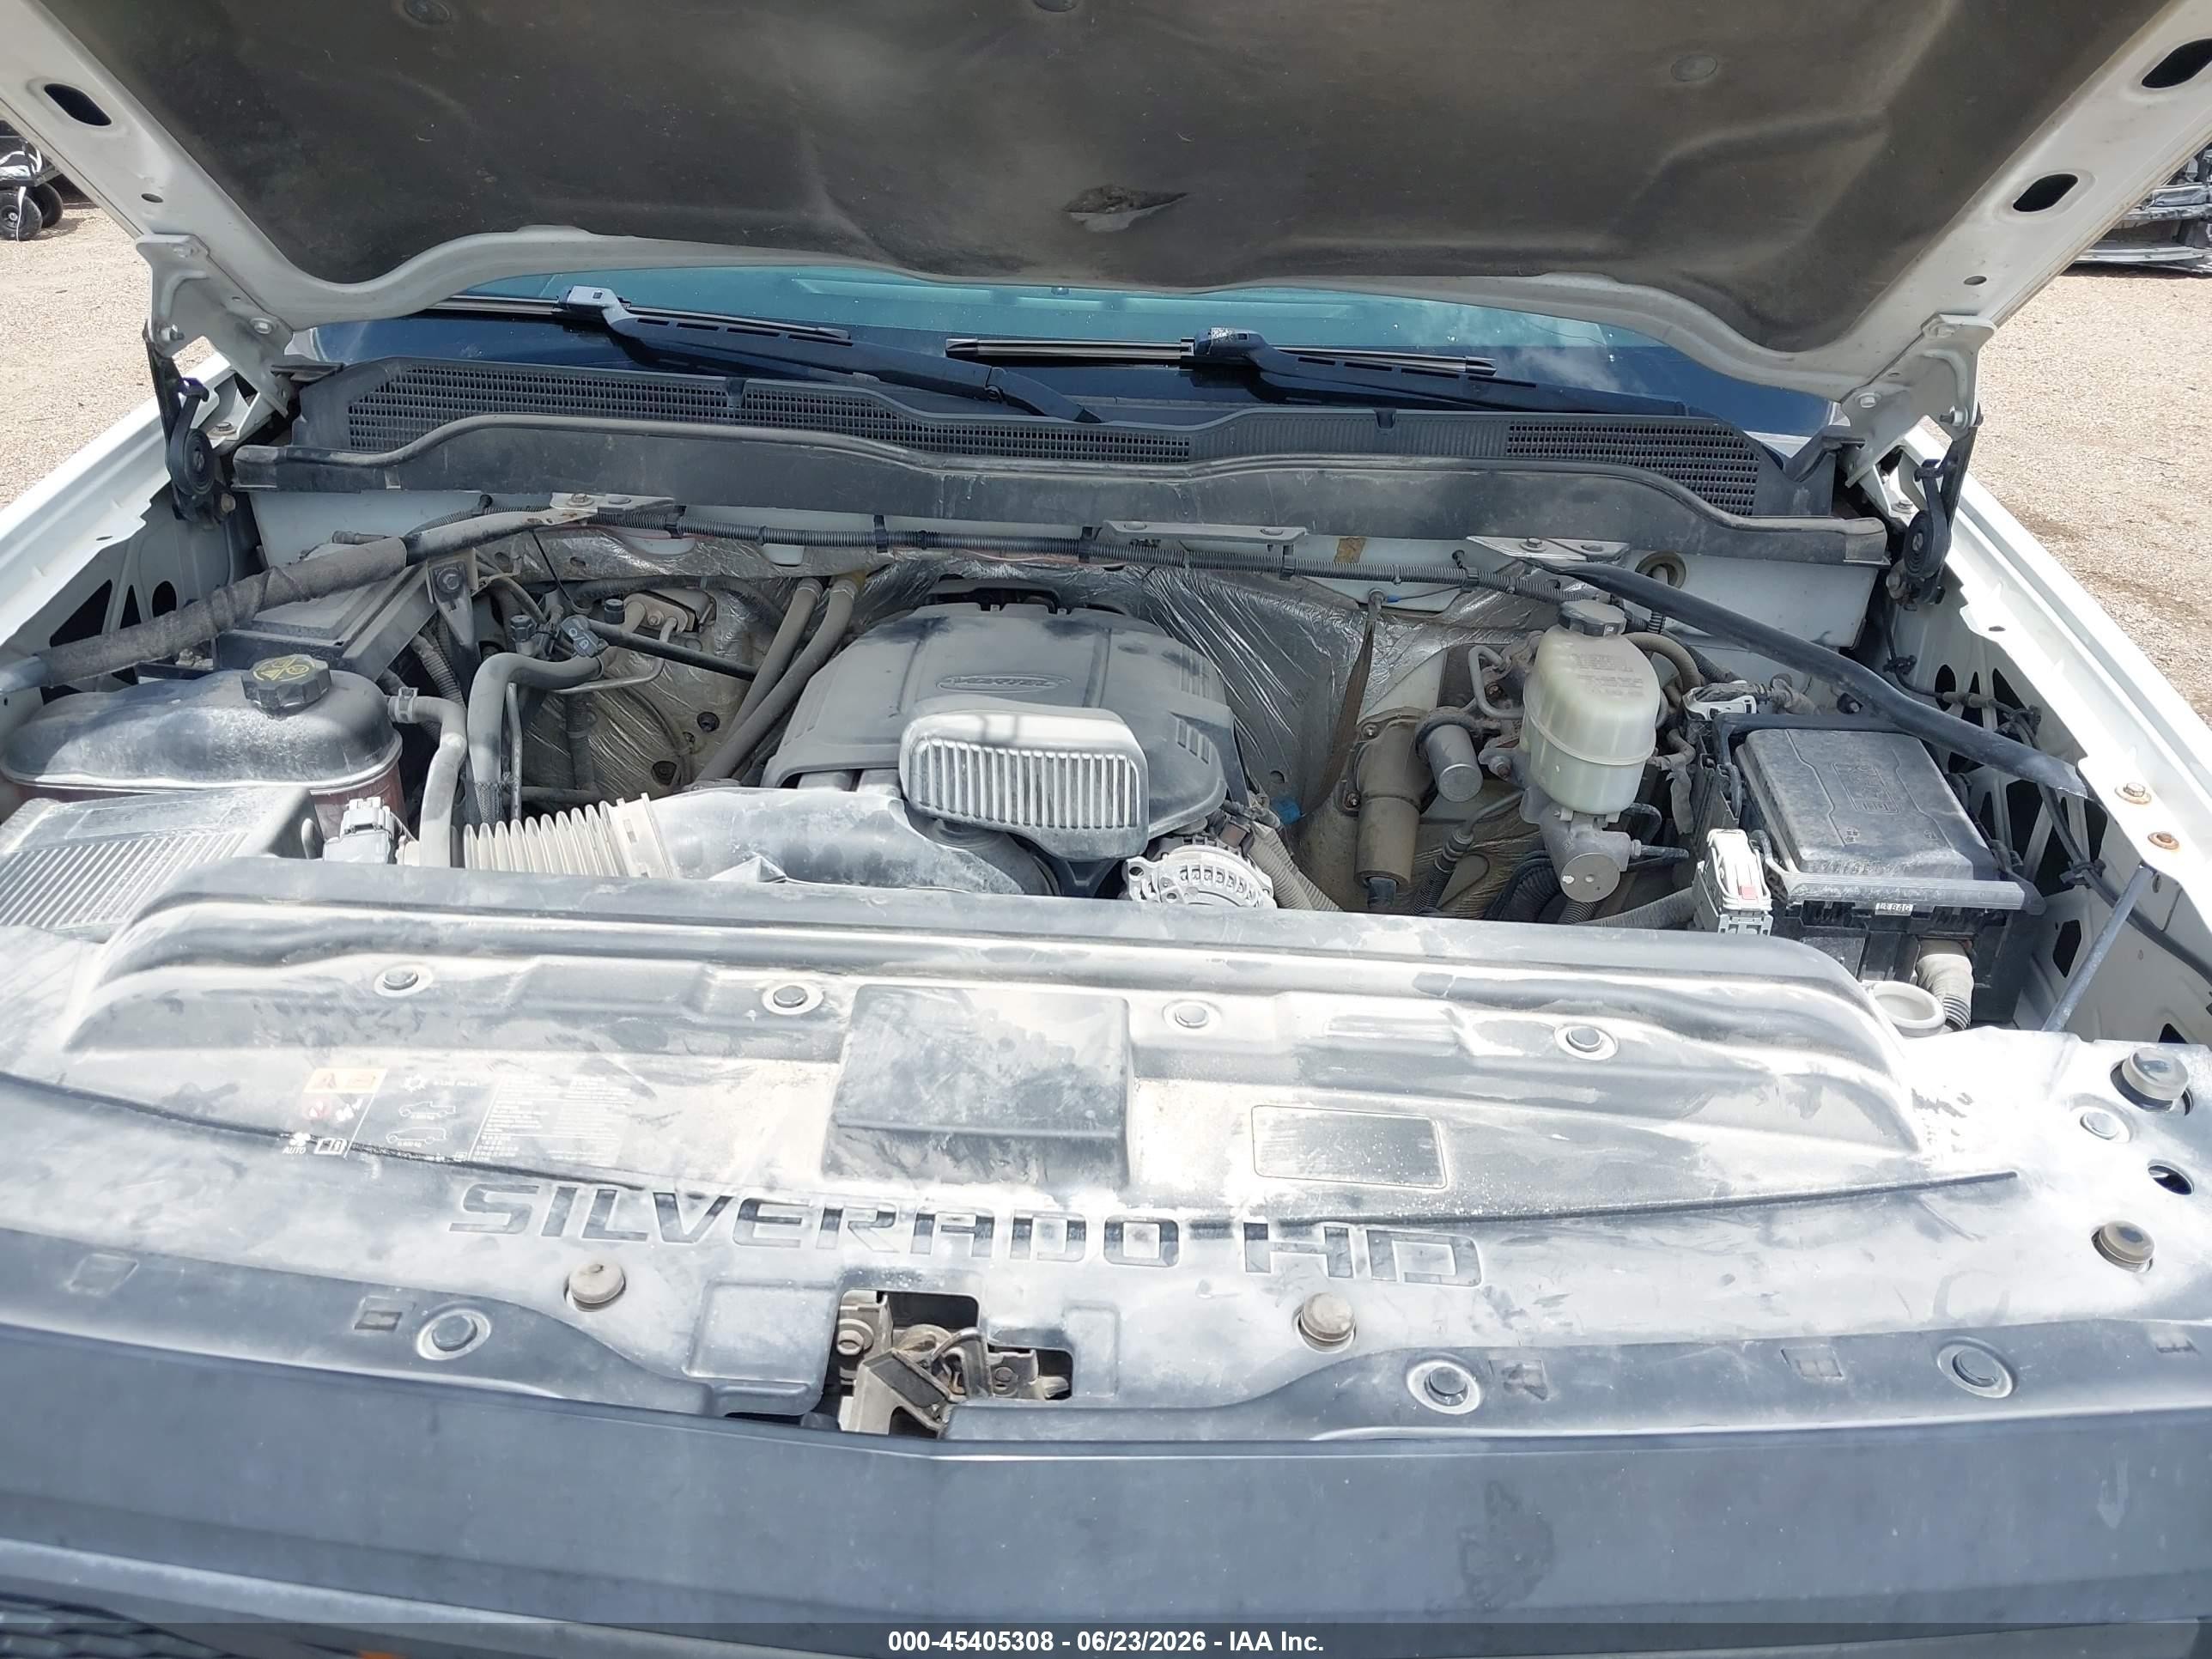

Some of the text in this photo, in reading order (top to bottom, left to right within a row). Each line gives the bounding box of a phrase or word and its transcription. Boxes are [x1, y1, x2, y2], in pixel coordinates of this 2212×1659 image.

[282, 1146, 307, 1155] AUTO
[448, 1182, 1483, 1287] SILVERADO HD
